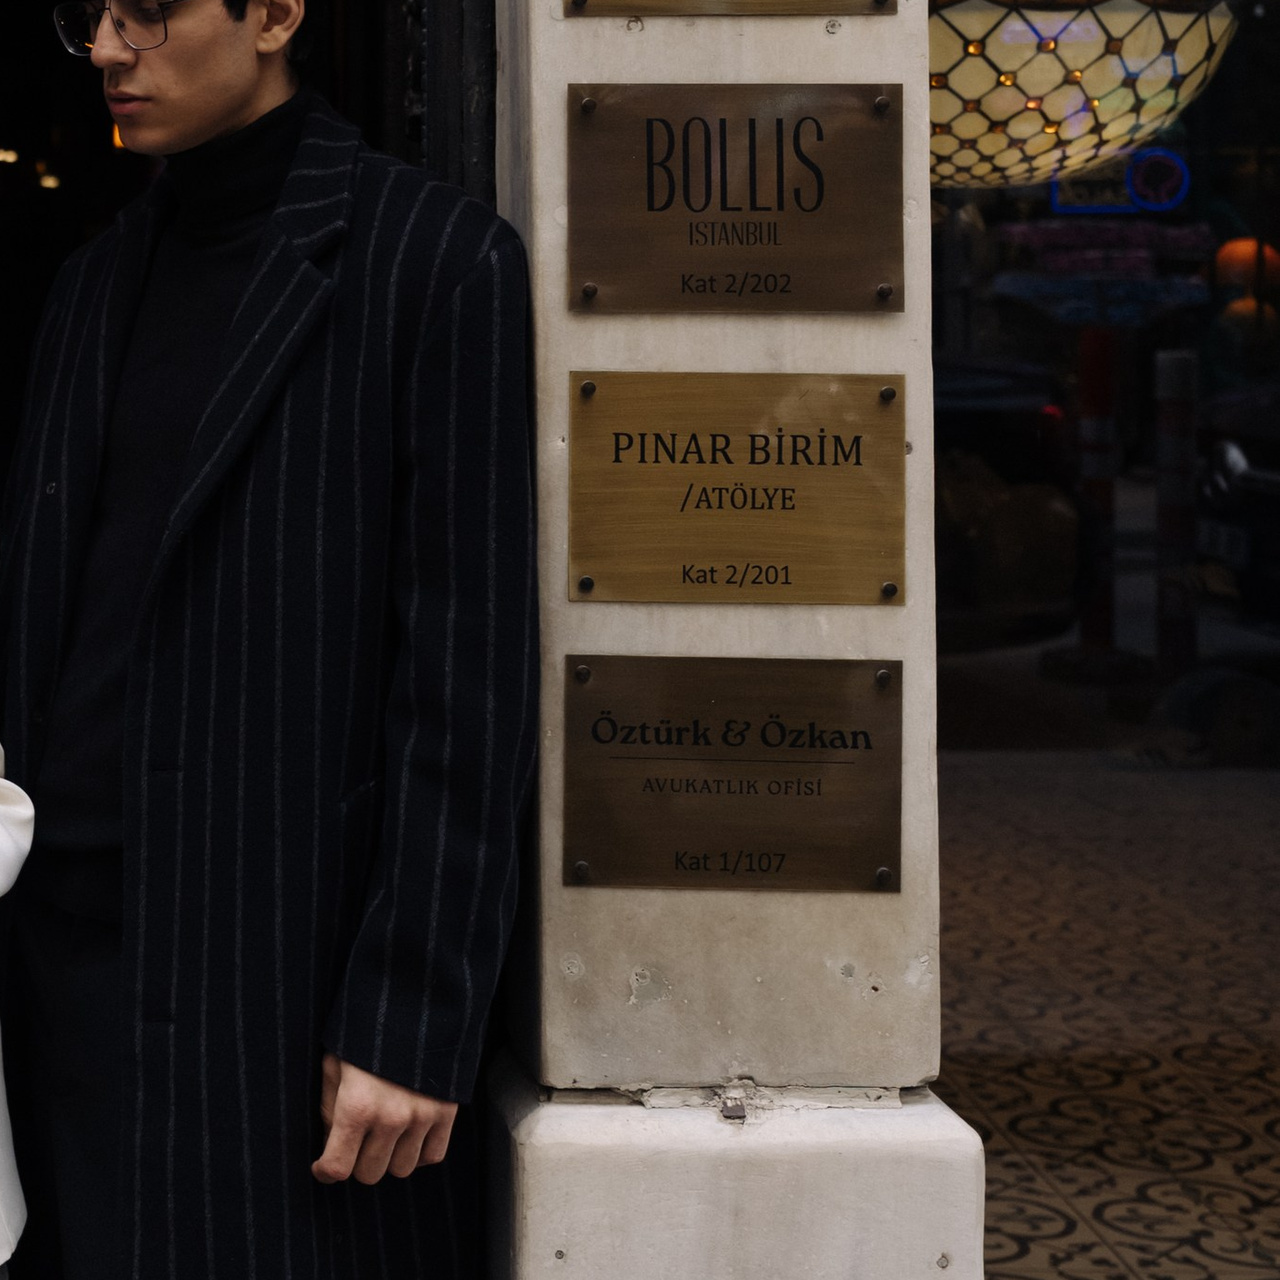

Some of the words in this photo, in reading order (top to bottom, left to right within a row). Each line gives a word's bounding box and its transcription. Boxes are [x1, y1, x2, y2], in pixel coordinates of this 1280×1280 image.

[646, 117, 824, 213] BOLLIS
[690, 222, 782, 245] ISTANBUL
[682, 274, 716, 293] Kat
[725, 272, 791, 296] 2/202
[613, 433, 734, 464] PINAR
[749, 428, 862, 465] BİRİM
[680, 483, 795, 512] /ATÖLYE
[683, 565, 717, 584] Kat
[726, 563, 791, 587] 2/201
[591, 711, 712, 746] Öztürk
[722, 720, 751, 746] &
[760, 714, 872, 749] Özkan
[642, 778, 758, 794] AVUKATLIK
[768, 778, 821, 795] OFİSİ
[675, 852, 710, 871] Kat
[720, 851, 786, 875] 1/107
